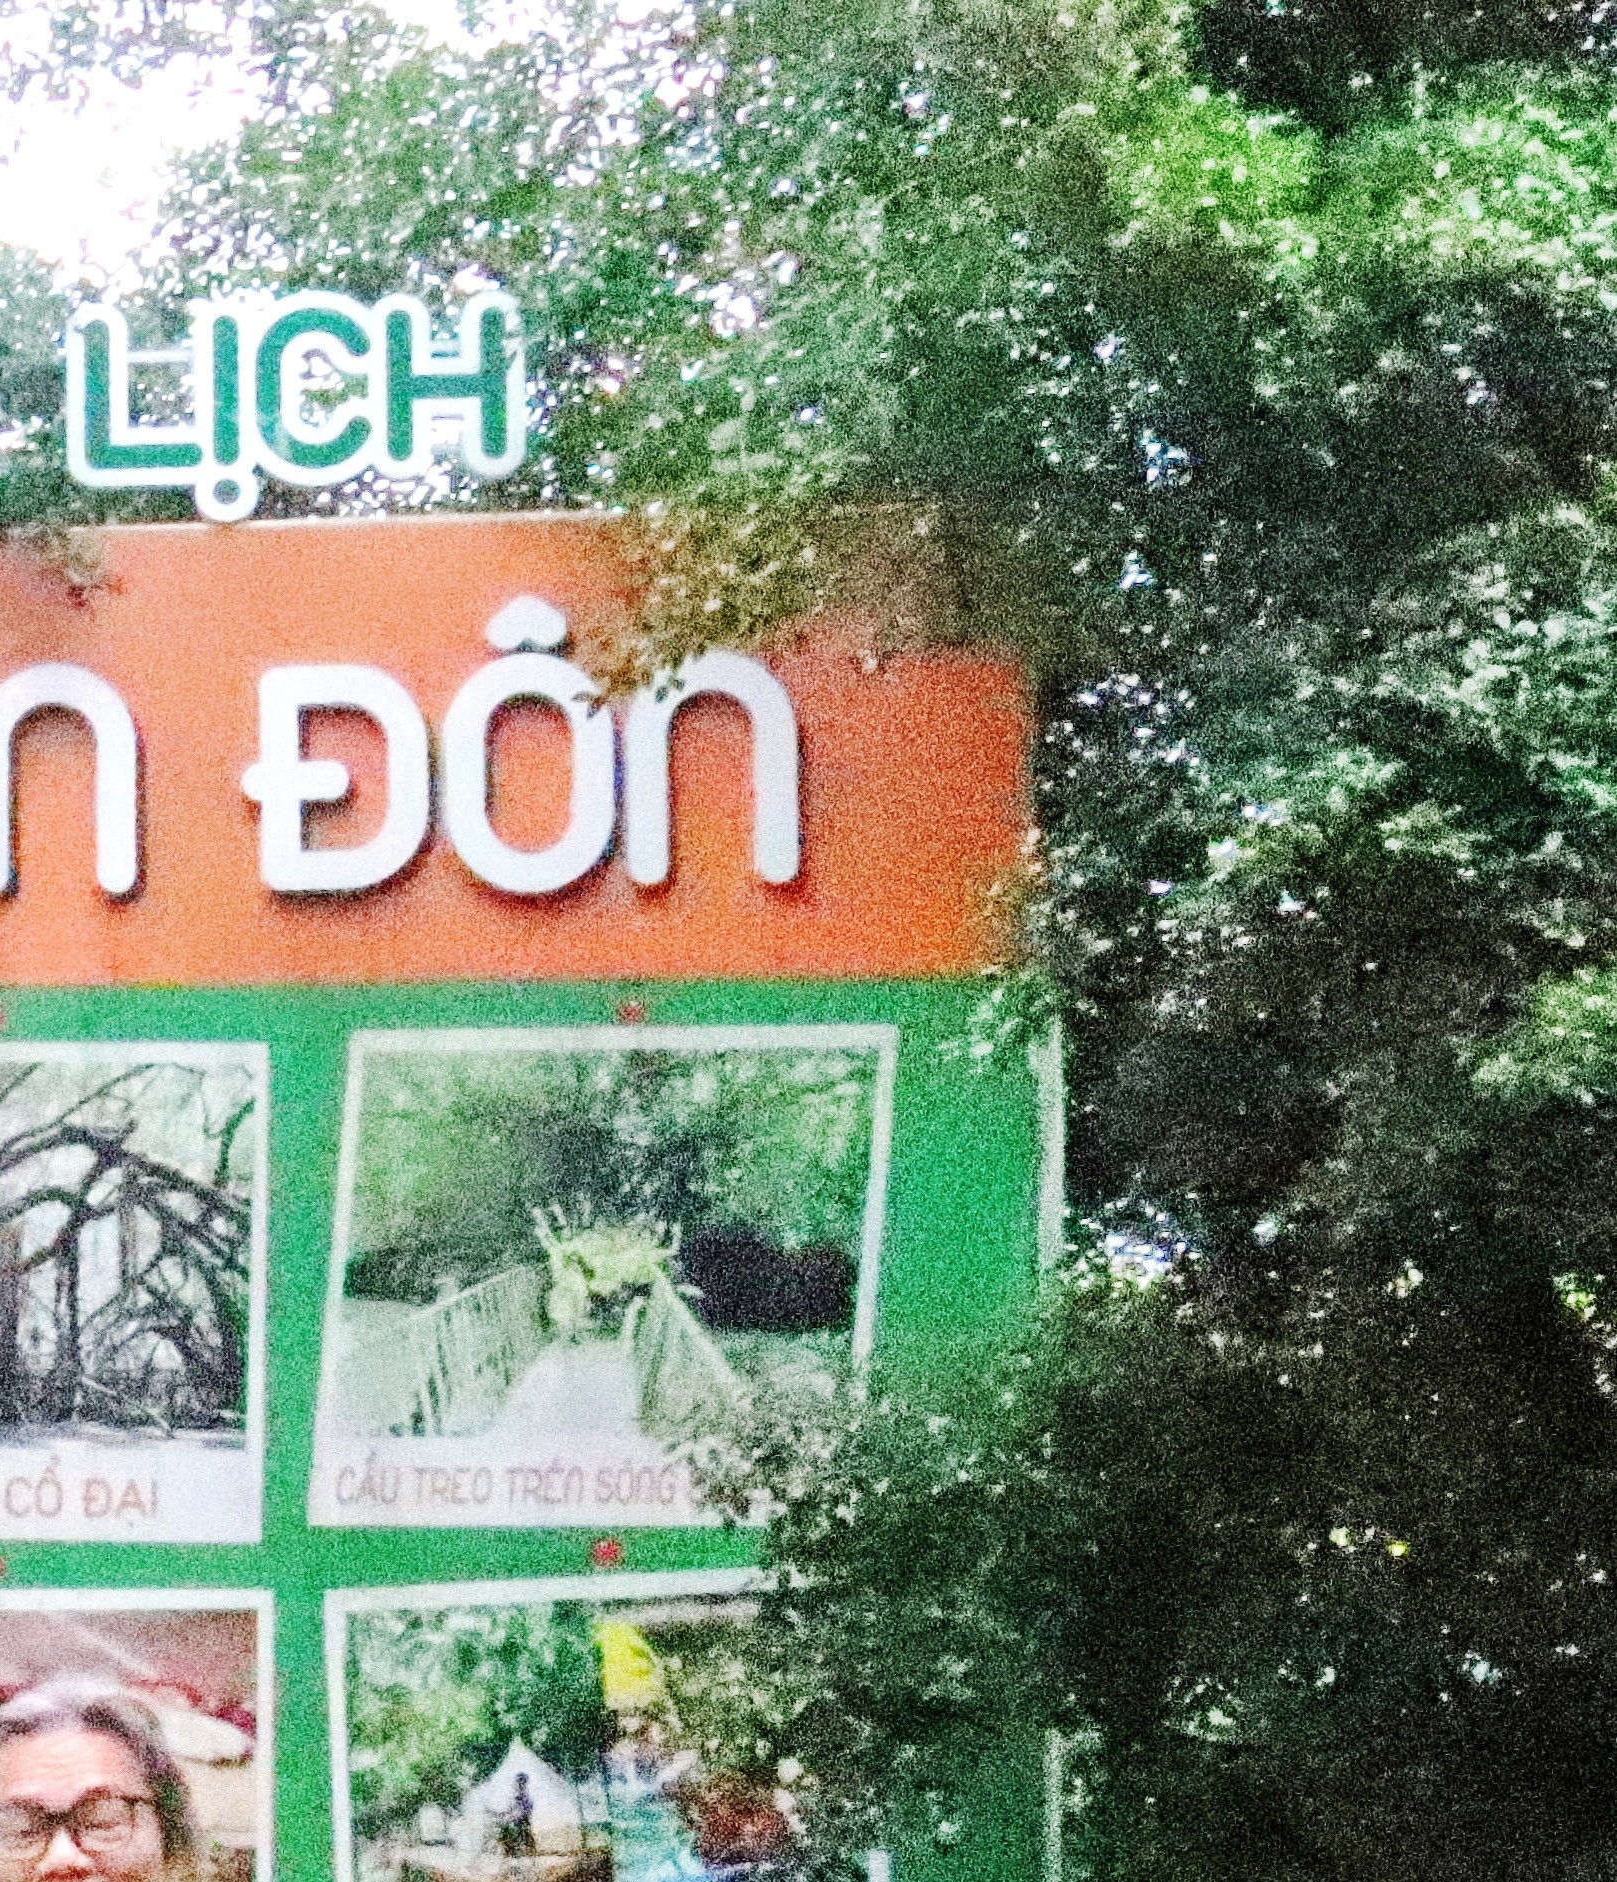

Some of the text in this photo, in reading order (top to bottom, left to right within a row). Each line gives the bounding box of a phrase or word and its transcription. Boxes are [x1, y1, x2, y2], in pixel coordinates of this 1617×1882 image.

[67, 290, 526, 523] LỊCH
[241, 597, 801, 893] ĐÔN
[413, 1465, 493, 1506] TREO
